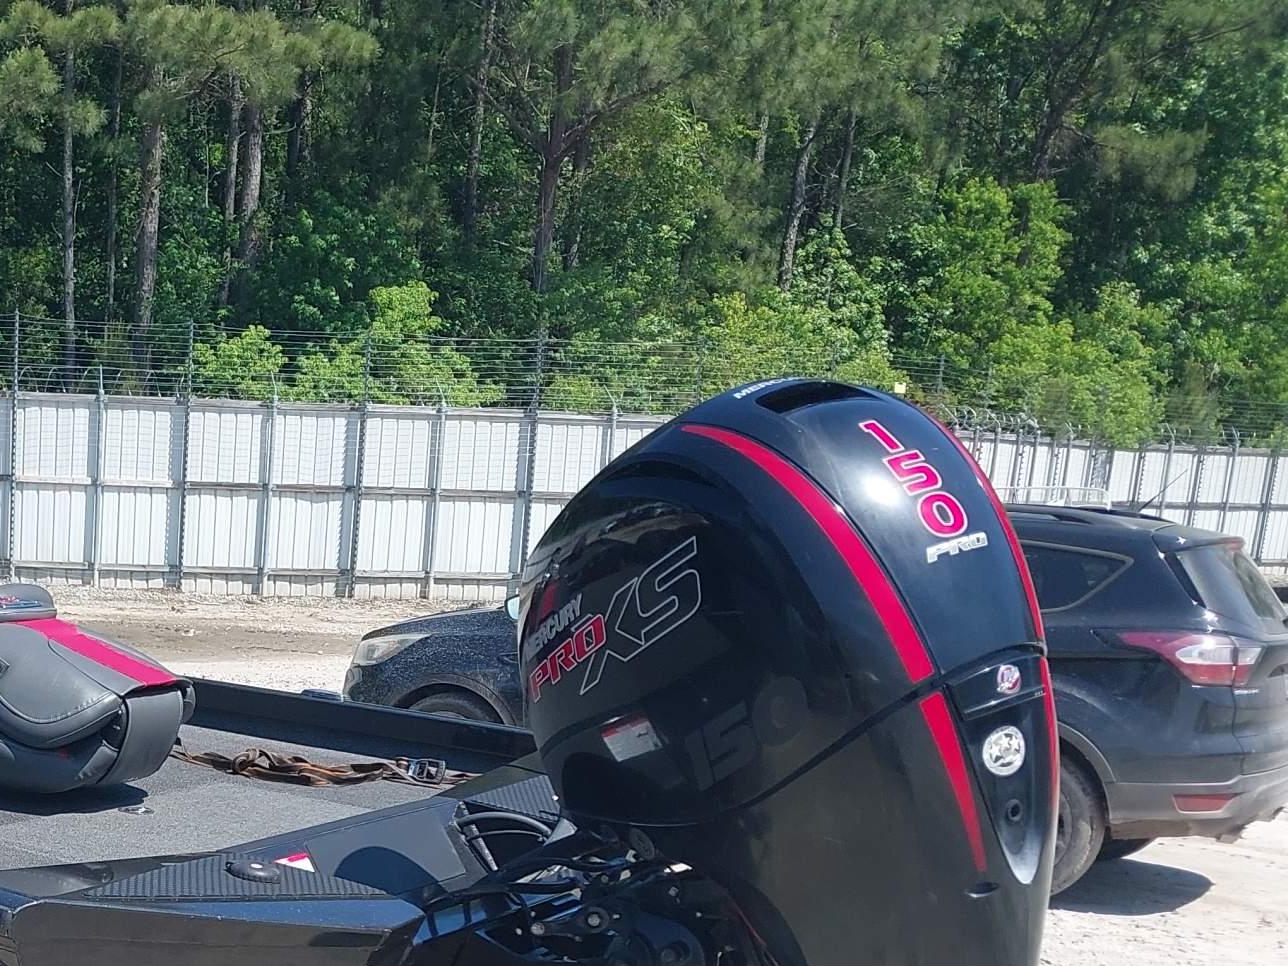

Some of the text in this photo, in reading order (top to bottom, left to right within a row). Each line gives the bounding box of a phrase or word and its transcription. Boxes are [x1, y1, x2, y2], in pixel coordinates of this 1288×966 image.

[858, 420, 968, 538] 150
[529, 535, 702, 703] PRO XS
